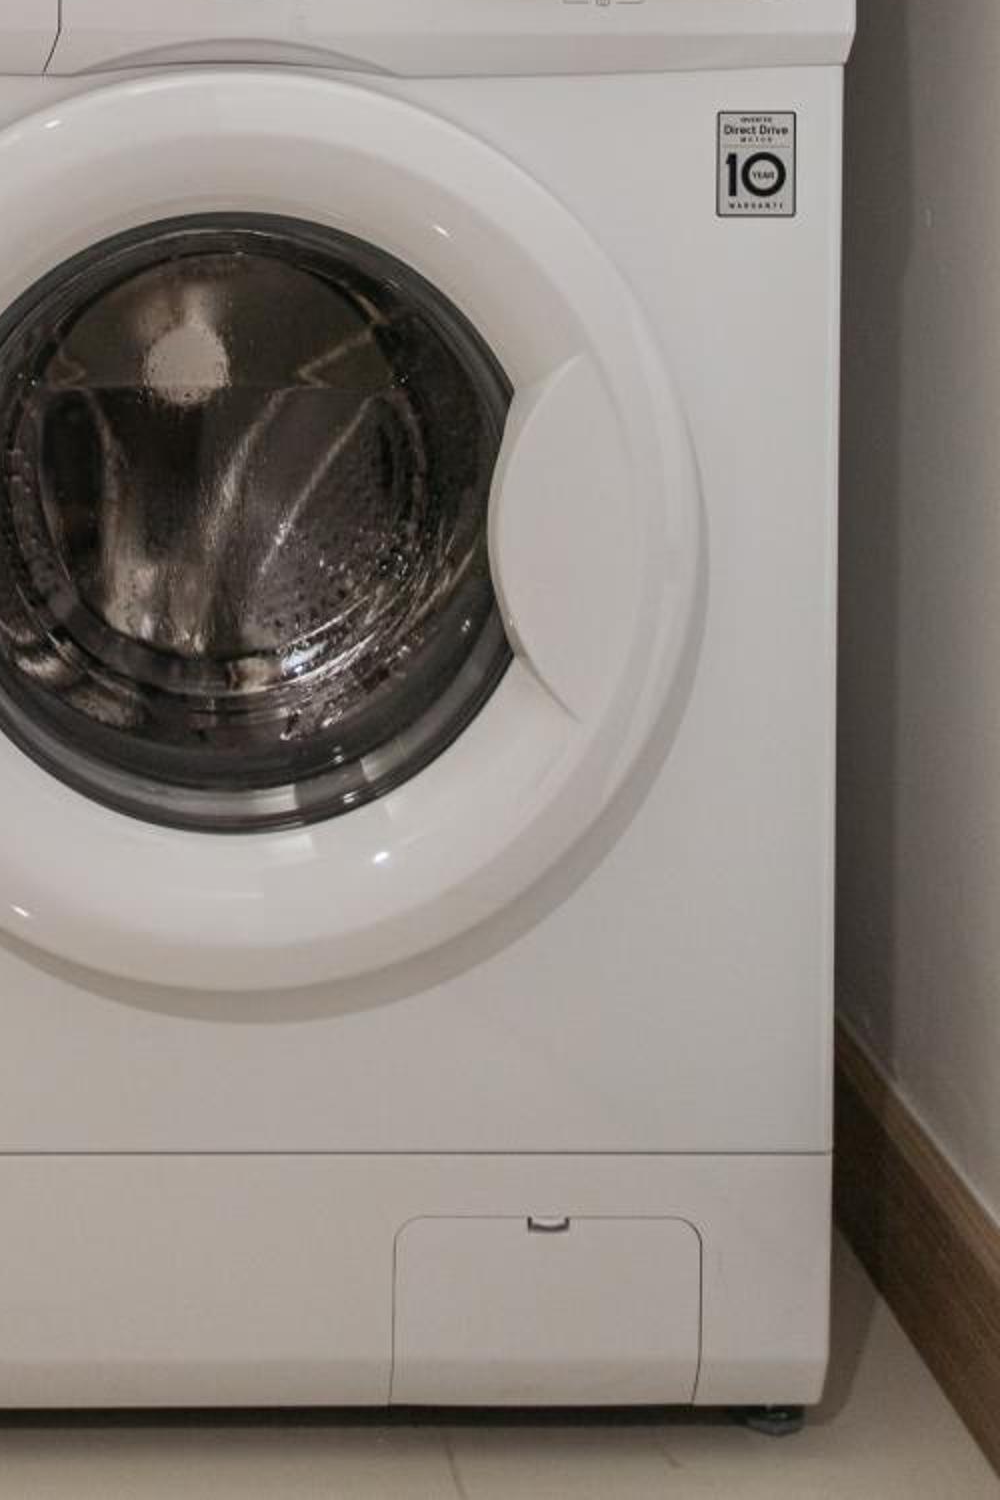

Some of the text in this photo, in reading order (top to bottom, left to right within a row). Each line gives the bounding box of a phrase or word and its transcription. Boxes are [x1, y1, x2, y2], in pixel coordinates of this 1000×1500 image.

[724, 124, 789, 135] Direct Drive
[725, 151, 787, 198] 10
